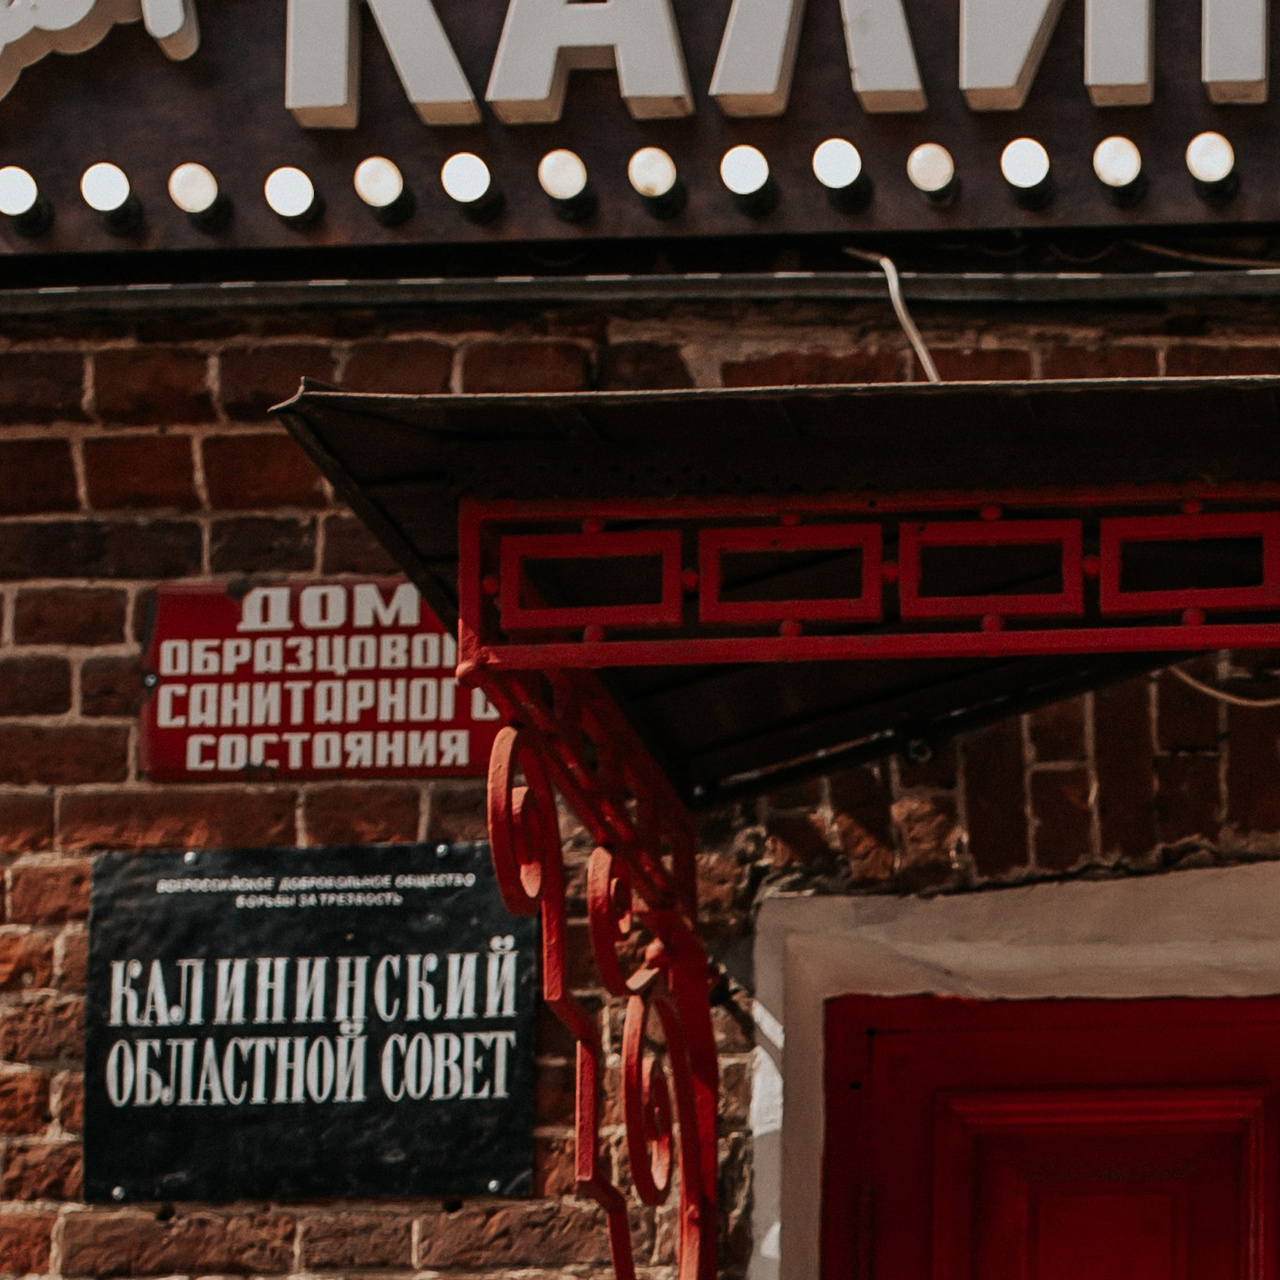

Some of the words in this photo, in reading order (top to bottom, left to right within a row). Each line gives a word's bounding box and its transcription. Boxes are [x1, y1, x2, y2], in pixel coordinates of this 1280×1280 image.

[237, 583, 420, 632] ДОМ
[186, 730, 469, 772] СОСТОЯНИЯ
[108, 935, 519, 1027] КАЛИНИНСКИЙ
[106, 1020, 367, 1107] ОБЛАСТНОЙ
[381, 1031, 517, 1102] СОВЕТ
